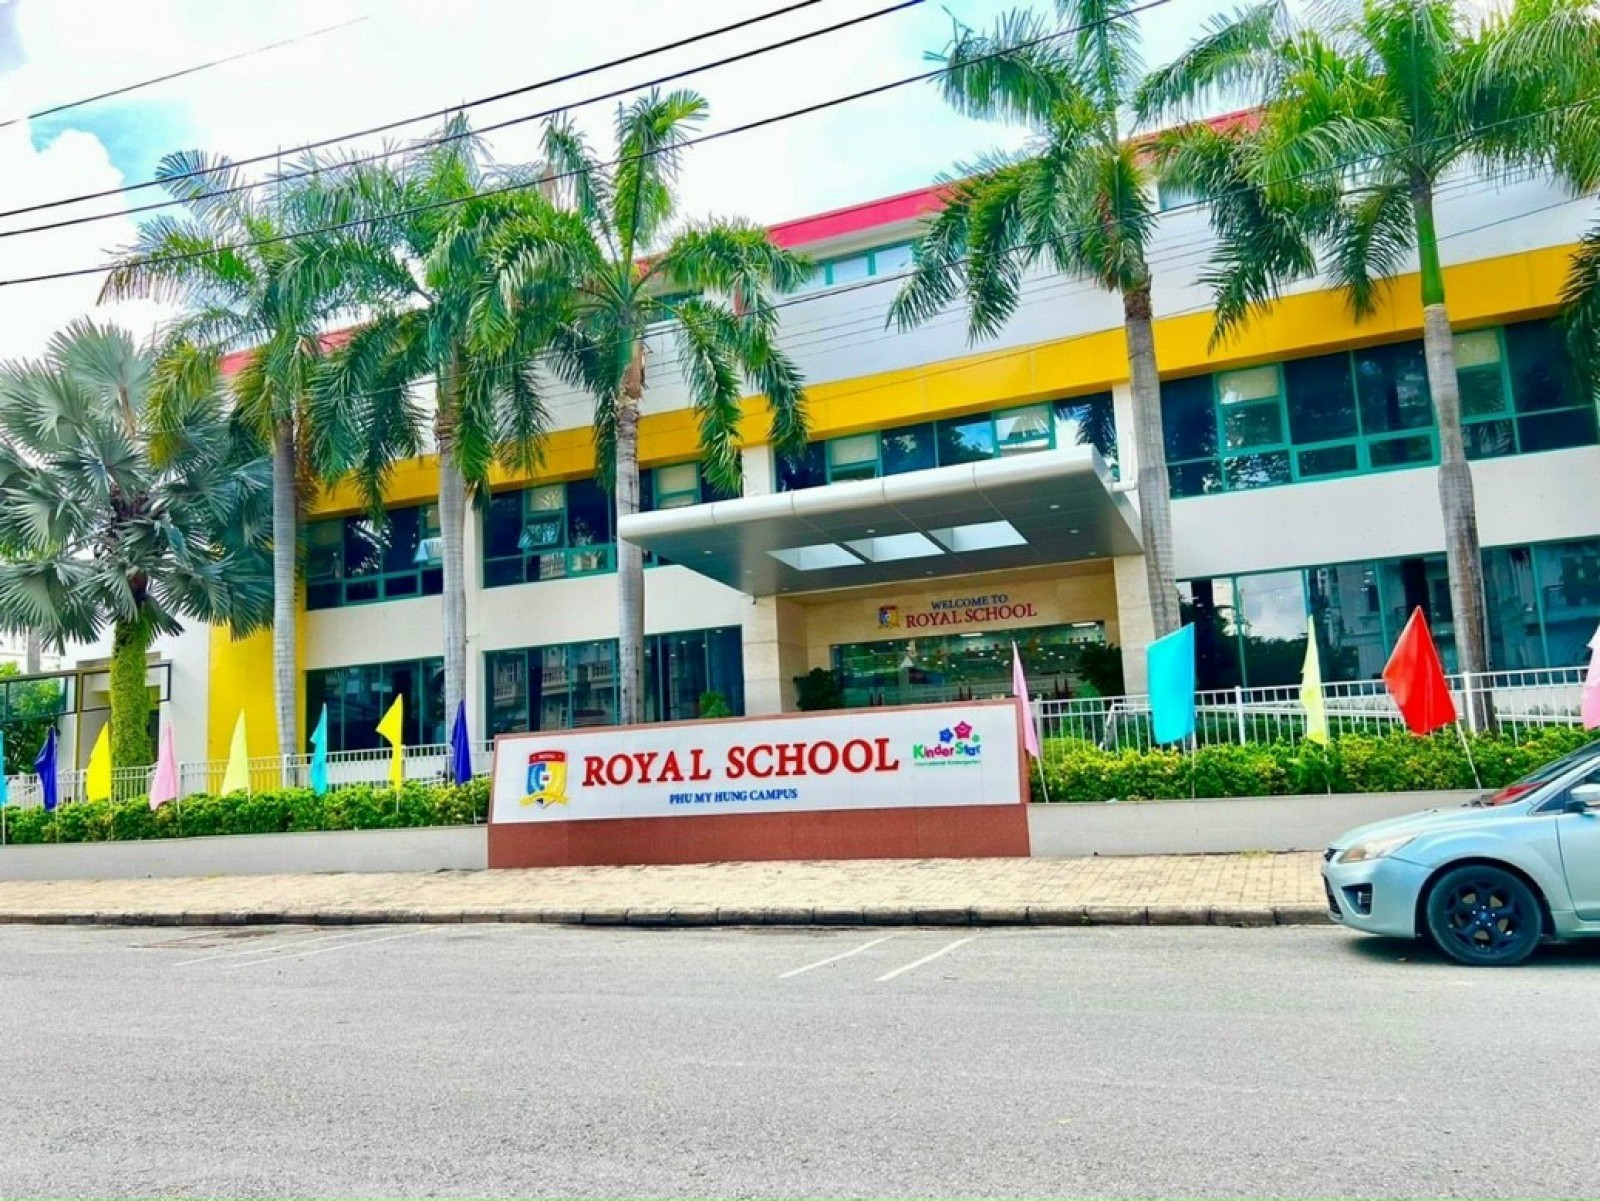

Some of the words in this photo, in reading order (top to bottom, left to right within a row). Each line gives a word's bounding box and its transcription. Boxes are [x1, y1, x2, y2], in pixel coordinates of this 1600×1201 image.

[931, 596, 990, 610] WELCOME
[991, 594, 1008, 604] TO
[906, 610, 962, 628] ROYAL
[965, 603, 1038, 622] SCHOOL
[582, 749, 711, 787] ROYAL
[726, 738, 899, 779] SCHOOL
[669, 791, 693, 804] PHU
[693, 790, 713, 803] MY
[714, 789, 748, 803] HUNG
[749, 786, 799, 801] CAMPUS
